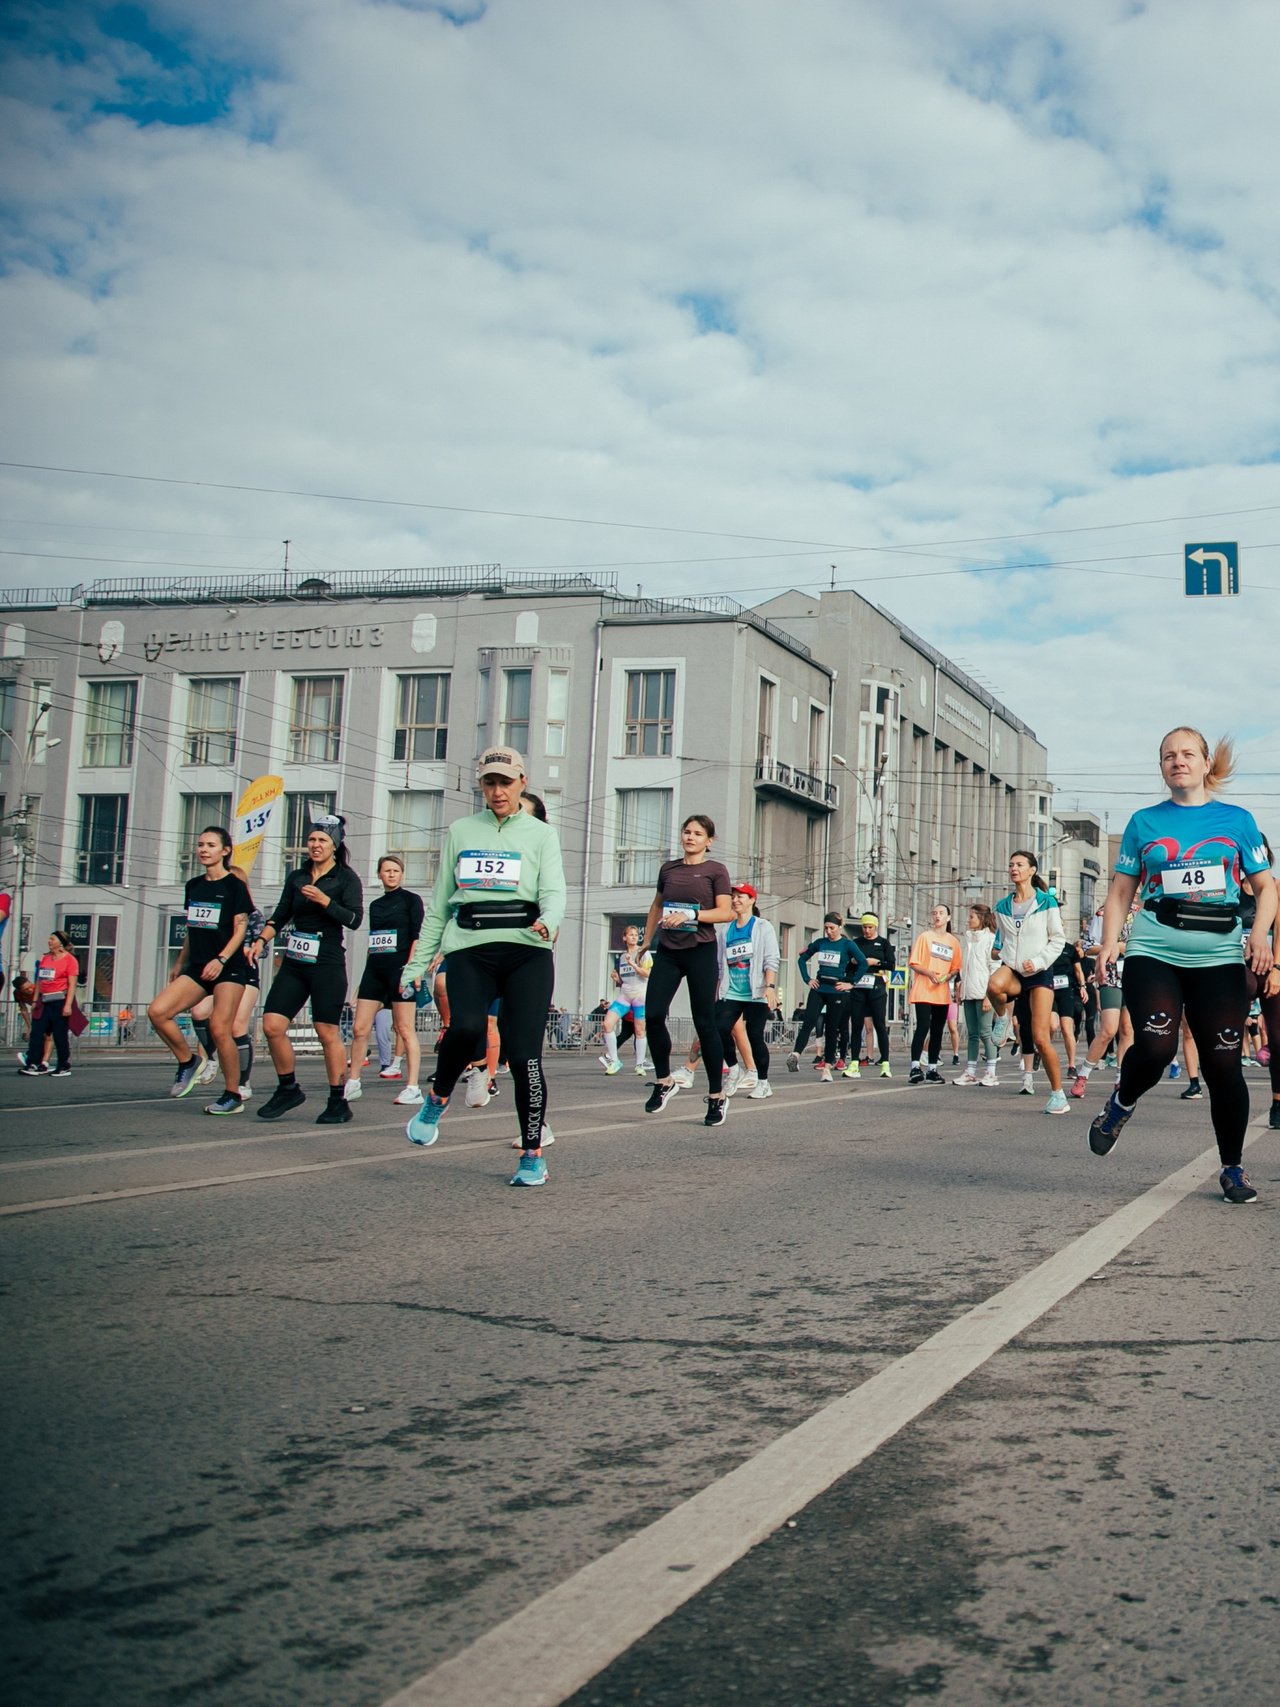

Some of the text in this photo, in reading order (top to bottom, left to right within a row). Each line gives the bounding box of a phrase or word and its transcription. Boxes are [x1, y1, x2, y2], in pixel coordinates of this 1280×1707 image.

[475, 860, 505, 874] 152
[1181, 869, 1206, 886] 48
[196, 908, 212, 918] 127
[70, 923, 88, 931] РИВ
[69, 930, 87, 938] ГОШ
[292, 939, 310, 952] 760
[371, 936, 393, 946] 1086
[731, 945, 747, 956] 842
[823, 953, 835, 961] 377
[527, 1058, 542, 1141] SHOCK ABSORBER
